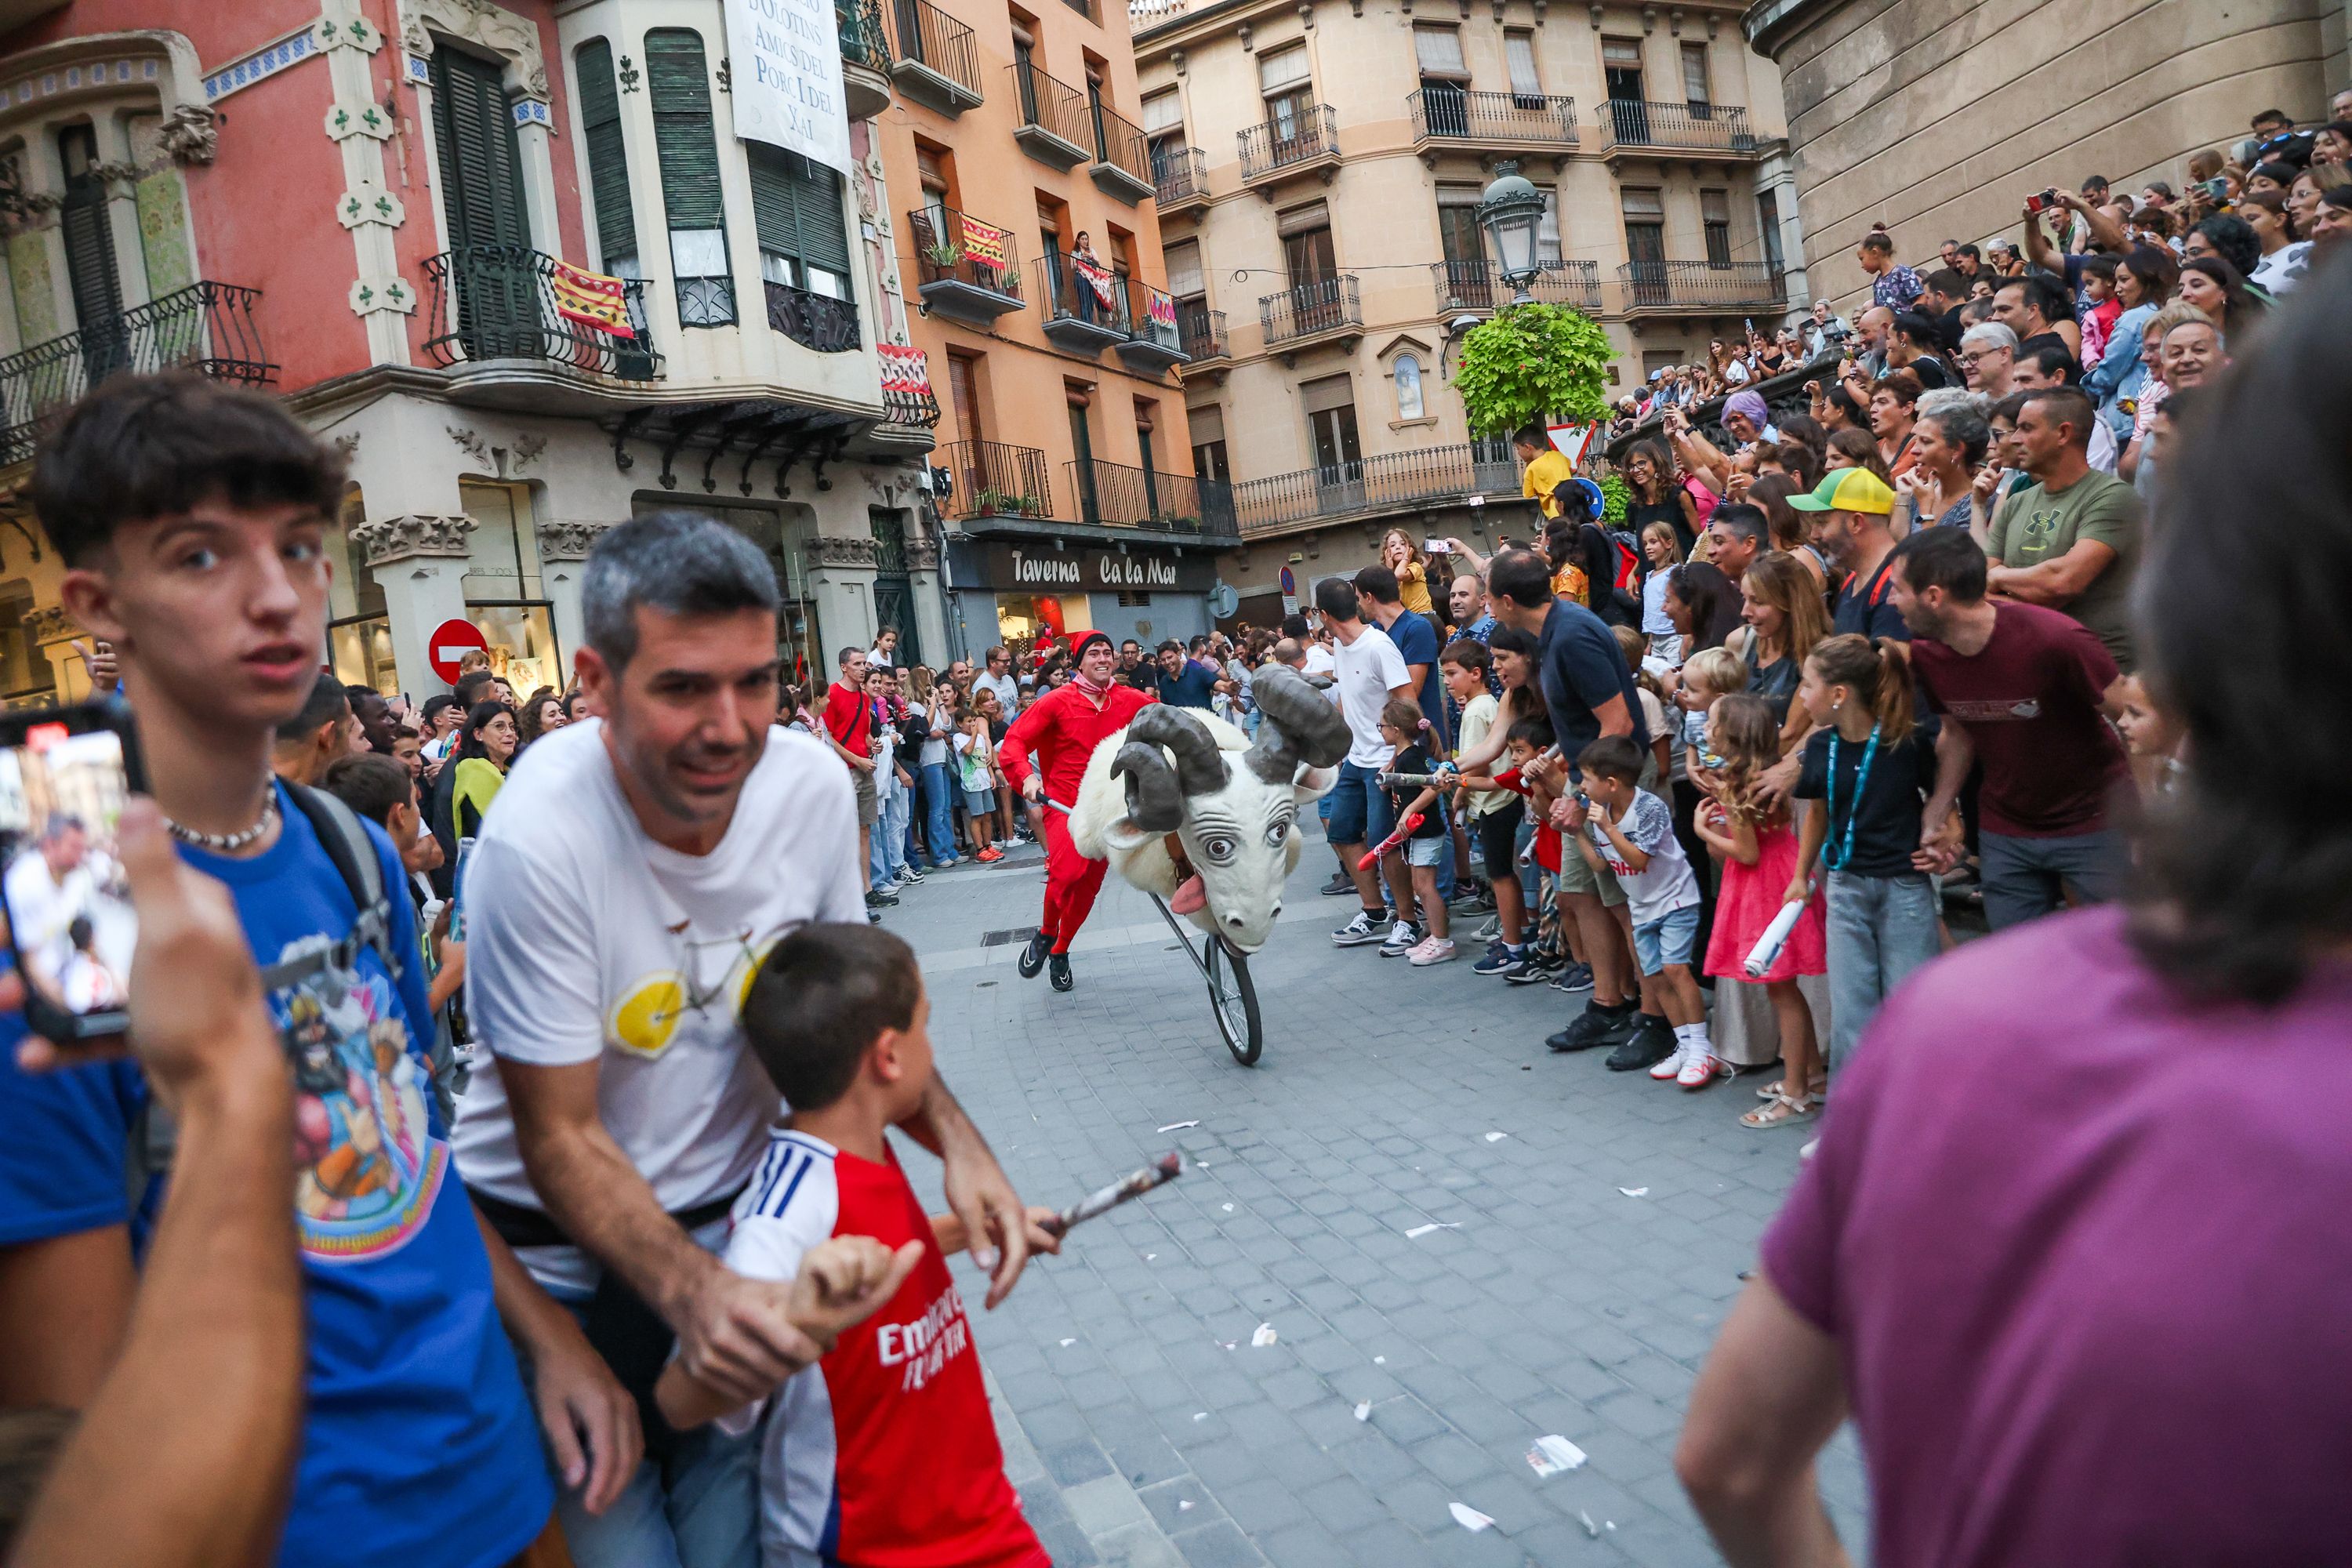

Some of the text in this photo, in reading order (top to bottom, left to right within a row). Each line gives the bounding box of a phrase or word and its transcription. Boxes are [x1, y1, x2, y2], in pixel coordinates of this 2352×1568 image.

[755, 21, 827, 81] AMICS DEL
[754, 54, 834, 116] PORC I DEL
[787, 103, 814, 140] XAI
[1012, 550, 1176, 585] Taverna Ca la Mar
